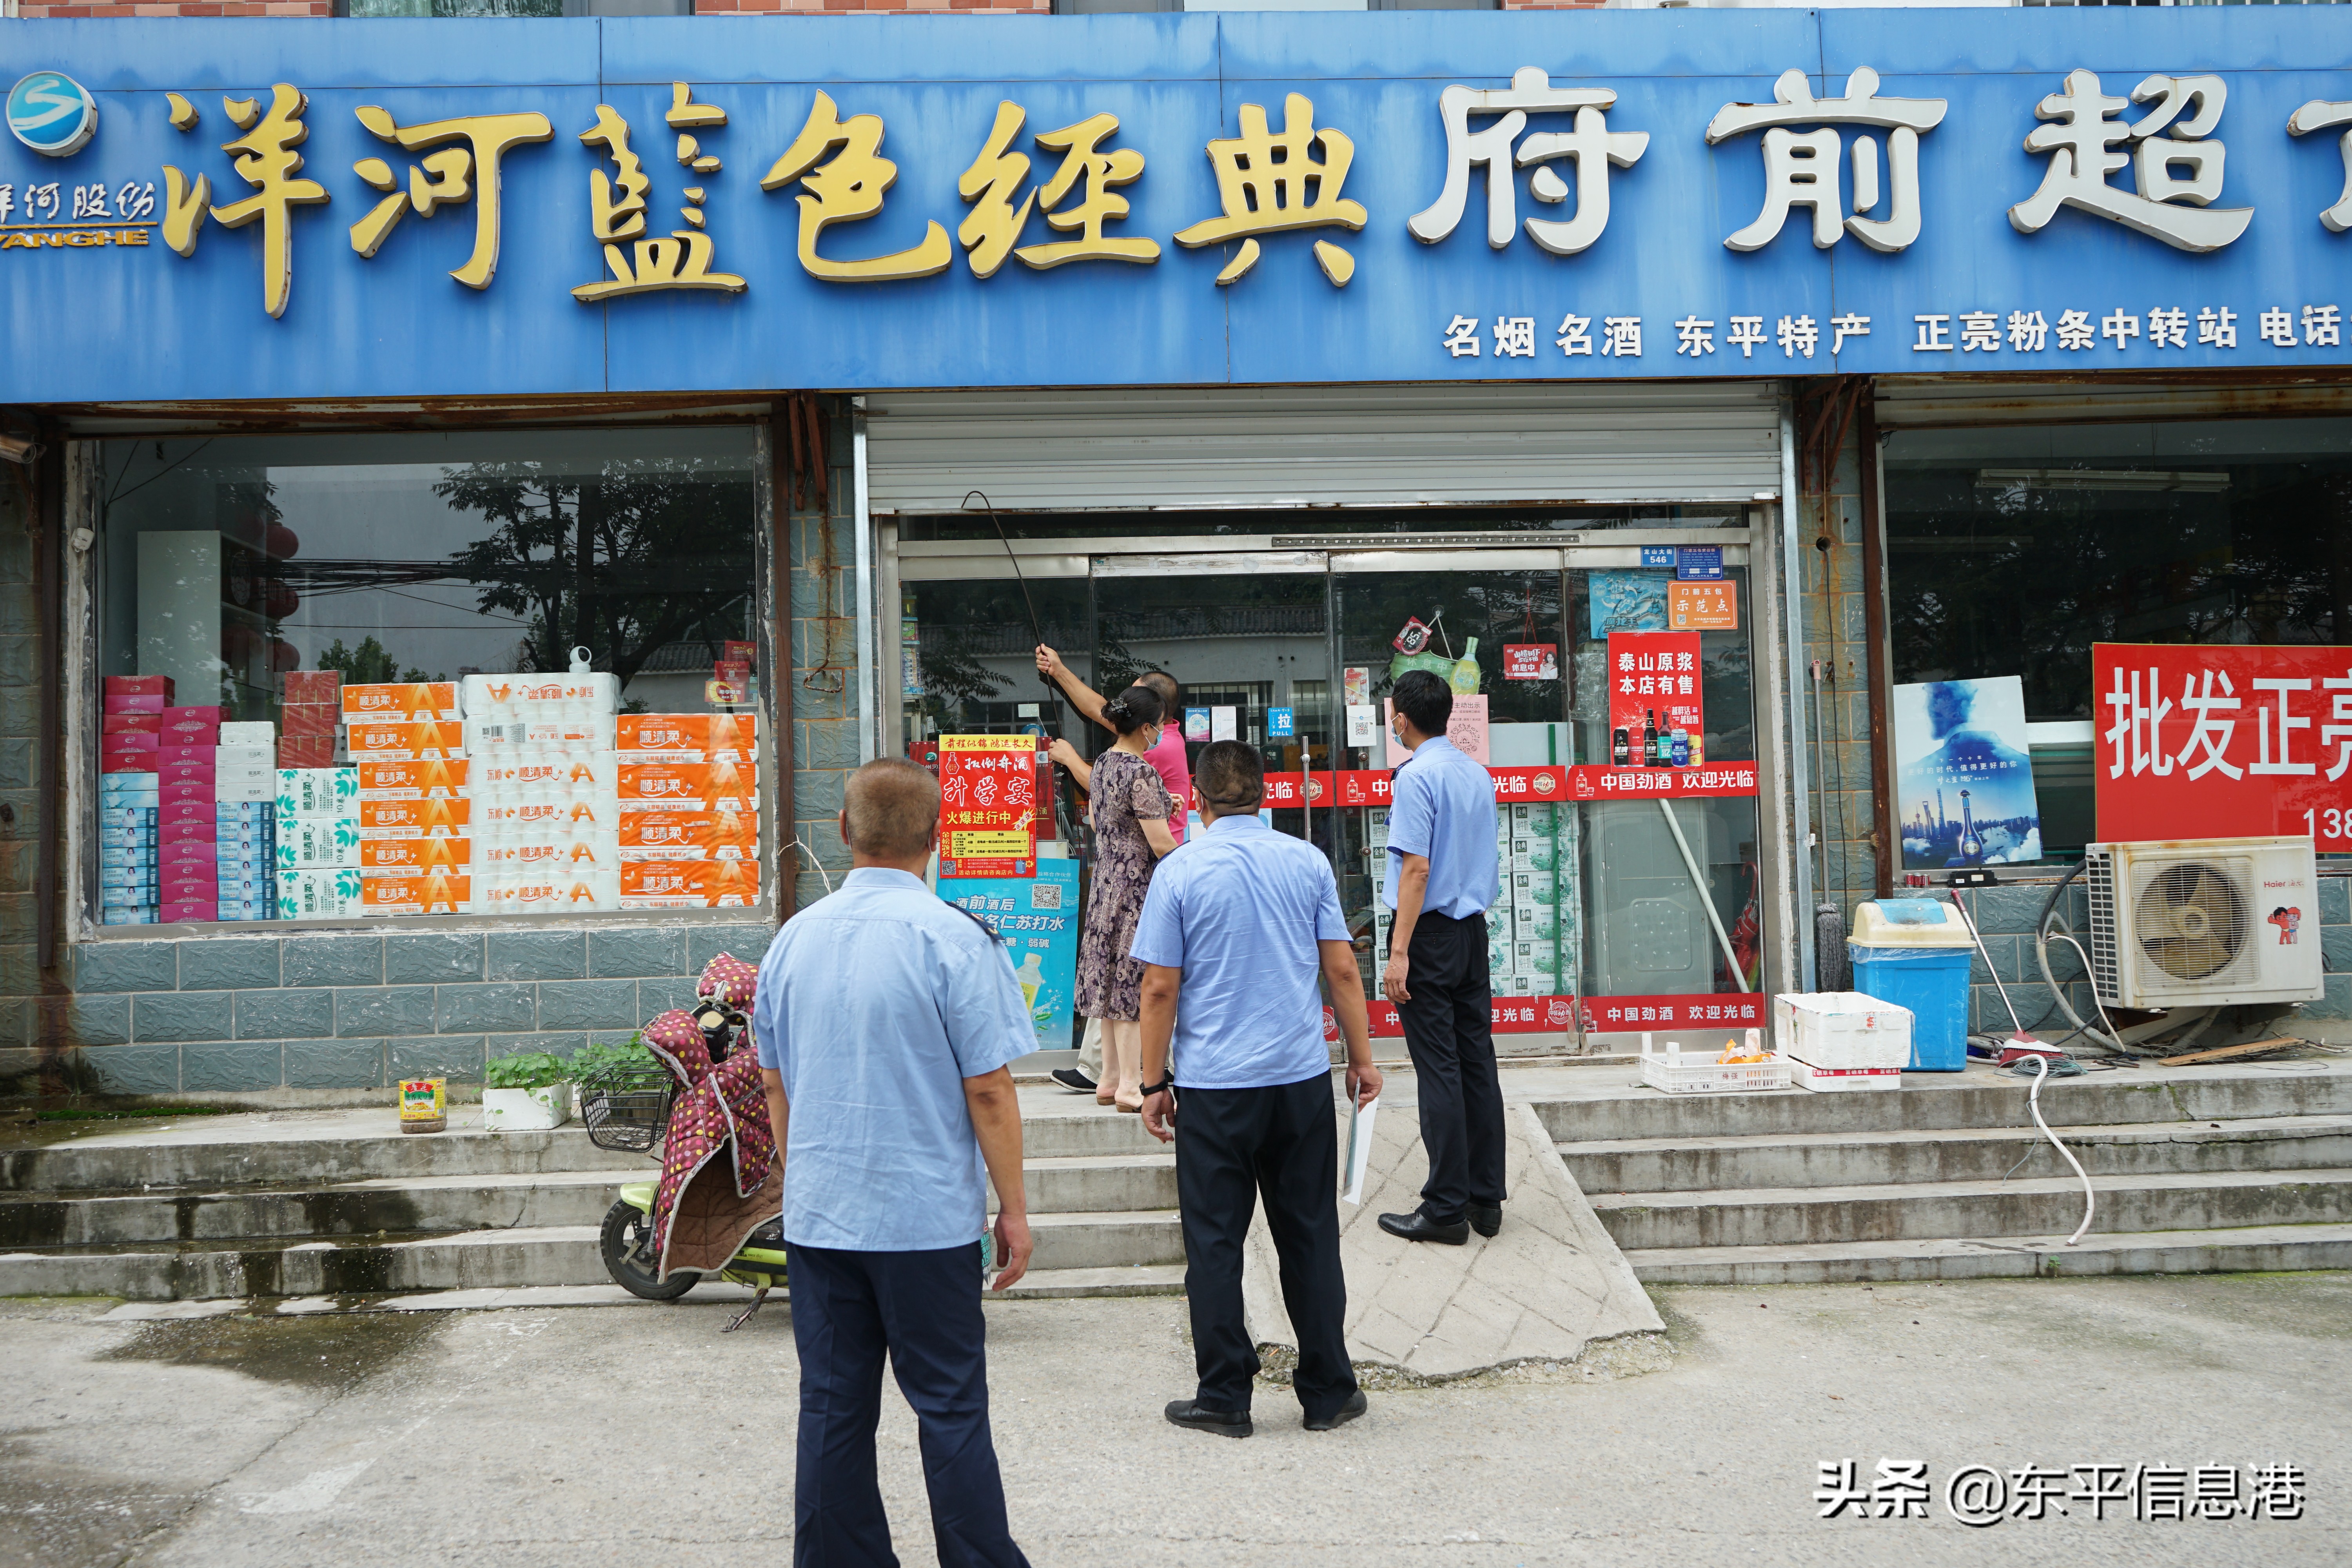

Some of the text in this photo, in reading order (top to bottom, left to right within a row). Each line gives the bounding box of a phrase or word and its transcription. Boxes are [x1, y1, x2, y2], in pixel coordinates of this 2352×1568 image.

[1443, 304, 2341, 358] 名烟 名酒 东平特产 正亮粉条中转站 电话
[1677, 598, 1728, 613] 示范点
[1406, 656, 1448, 672] 休息中
[1512, 664, 1535, 672] 休息中
[1618, 652, 1694, 672] 泰山原浆
[1619, 675, 1693, 695] 本店有售
[359, 695, 390, 706] 顺清柔
[1347, 694, 1356, 703] 推
[1278, 713, 1291, 729] 拉
[365, 733, 397, 744] 顺清柔
[639, 730, 680, 743] 顺清柔
[945, 737, 1033, 750] 前程似锦 鸿运长久
[965, 754, 1028, 773] 扳倒井酒
[376, 771, 406, 782] 顺清柔
[487, 769, 502, 780] 东顺
[519, 766, 553, 778] 顺清柔
[640, 779, 680, 792] 顺清柔
[1601, 770, 1754, 791] 中国劲酒 欢迎光临
[303, 782, 312, 810] 顺清柔
[944, 775, 1033, 807] 升学宴
[376, 810, 407, 821] 顺清柔
[488, 808, 502, 820] 东顺
[519, 805, 553, 817] 顺清柔
[946, 810, 1011, 825] 火爆进行中
[1373, 813, 1385, 821] 金典
[641, 826, 682, 840] 顺清柔
[303, 832, 312, 860] 顺清柔
[942, 831, 950, 857] 金榜题名
[1373, 847, 1385, 855] 金典
[376, 849, 407, 860] 顺清柔
[487, 849, 502, 860] 东顺
[519, 846, 553, 858] 顺清柔
[643, 876, 684, 889] 顺清柔
[304, 884, 314, 912] 顺清柔
[377, 887, 408, 898] 顺清柔
[487, 889, 502, 901] 东顺
[519, 886, 553, 898] 顺清柔
[1379, 915, 1390, 924] 金典
[1607, 1004, 1755, 1022] 中国劲酒 欢迎光临
